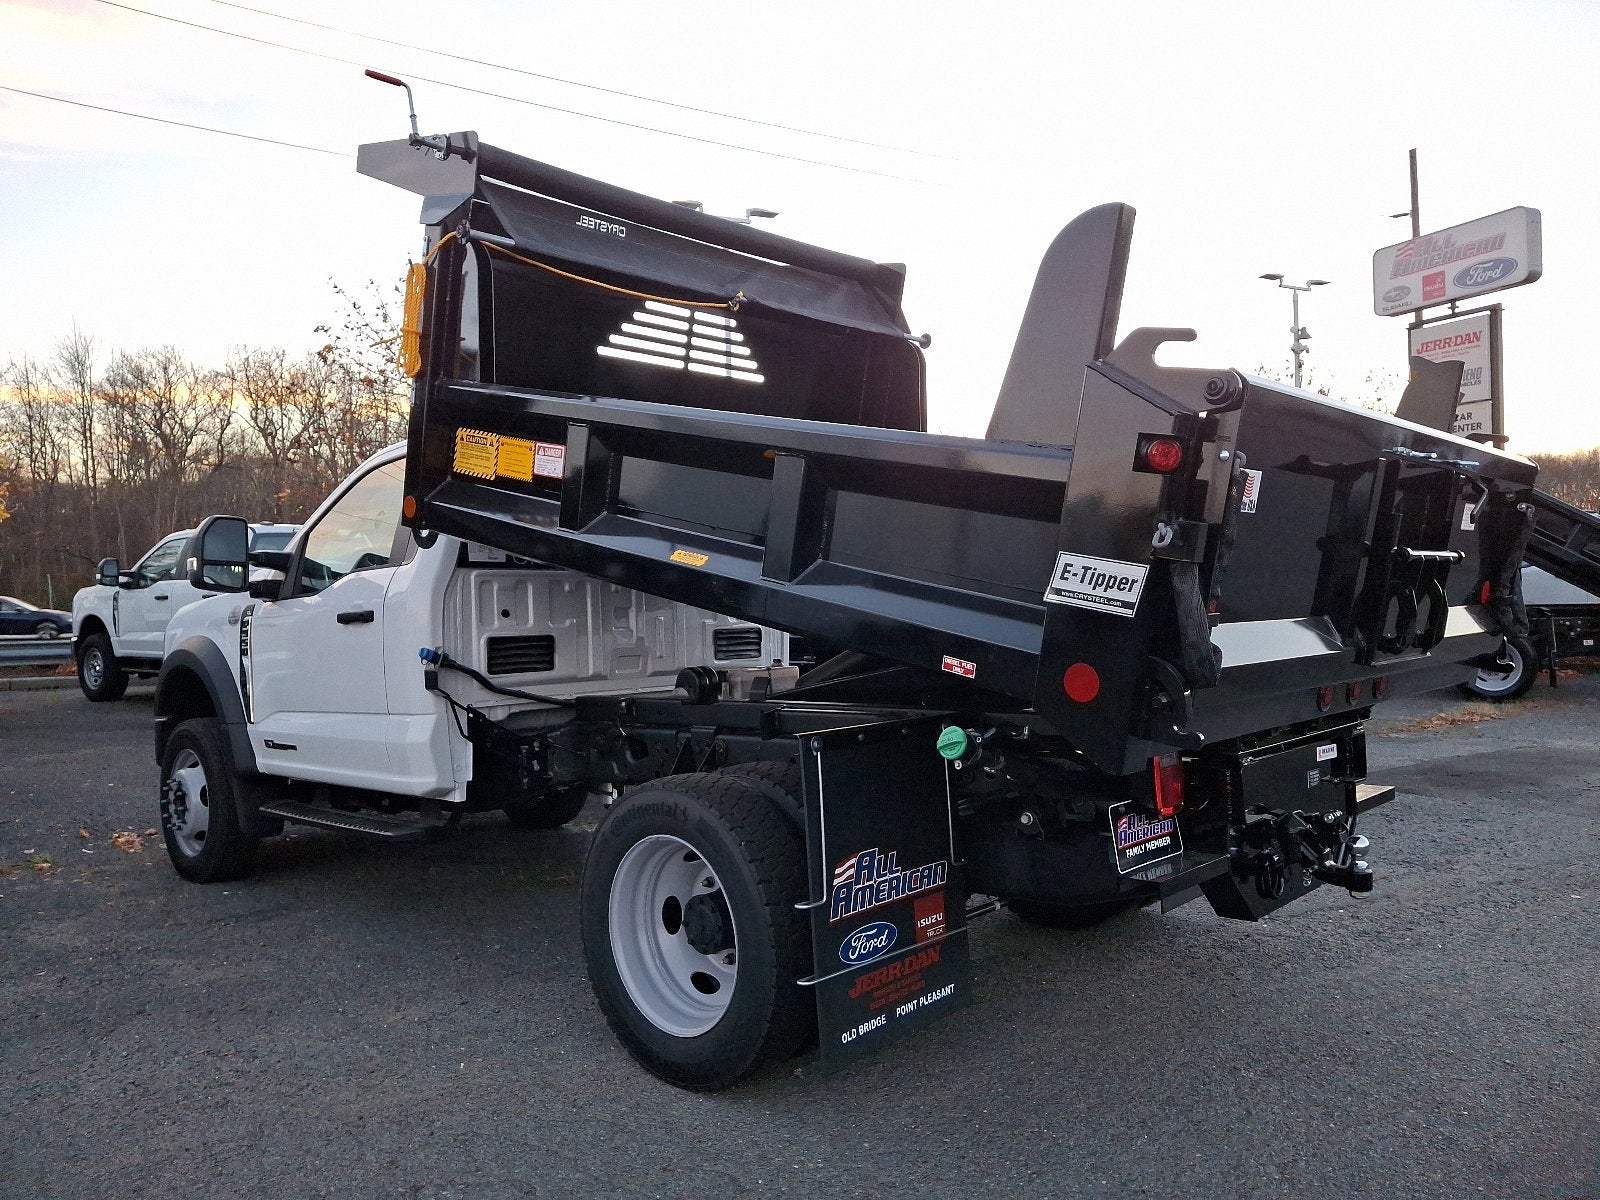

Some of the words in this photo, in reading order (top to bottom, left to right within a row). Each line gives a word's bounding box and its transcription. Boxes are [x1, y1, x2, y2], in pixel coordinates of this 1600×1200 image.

[1466, 262, 1504, 284] Ford
[1452, 422, 1482, 433] ENTER
[1060, 562, 1138, 592] E-Tipper
[962, 662, 974, 670] FUEL
[1118, 818, 1174, 848] AMERICAN
[1125, 843, 1145, 858] FAMILY
[1145, 836, 1171, 852] MEMBER
[854, 847, 902, 887] ALL
[829, 860, 948, 922] AMERICAN
[917, 912, 943, 928] ISUZU
[849, 928, 889, 960] Ford
[841, 1027, 857, 1044] OLD
[859, 1014, 887, 1036] BRIDGE
[896, 999, 918, 1018] POINT
[919, 983, 956, 1007] PLEASANT
